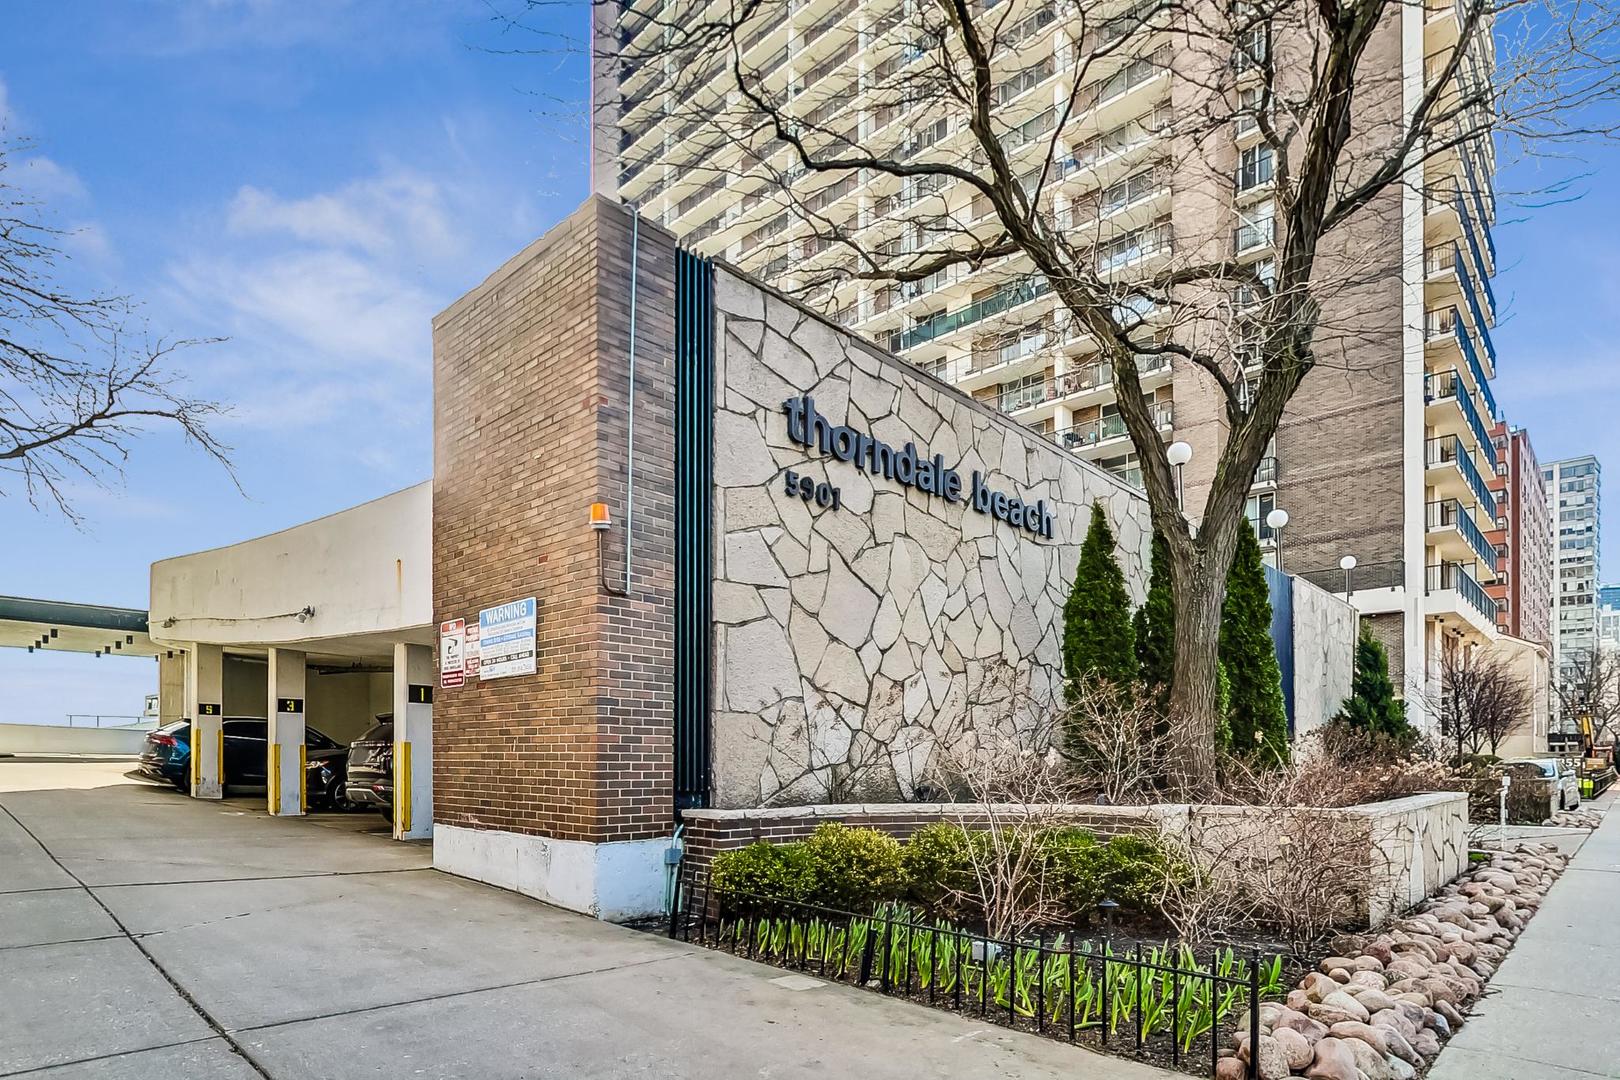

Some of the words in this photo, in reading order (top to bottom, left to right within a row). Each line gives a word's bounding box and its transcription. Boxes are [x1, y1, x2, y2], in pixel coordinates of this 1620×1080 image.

[782, 395, 962, 502] thorndale
[972, 470, 1054, 539] beach
[785, 469, 841, 511] 5901
[486, 602, 526, 624] WARNING
[420, 687, 424, 702] 1
[206, 705, 212, 714] 5
[286, 700, 294, 711] 3
